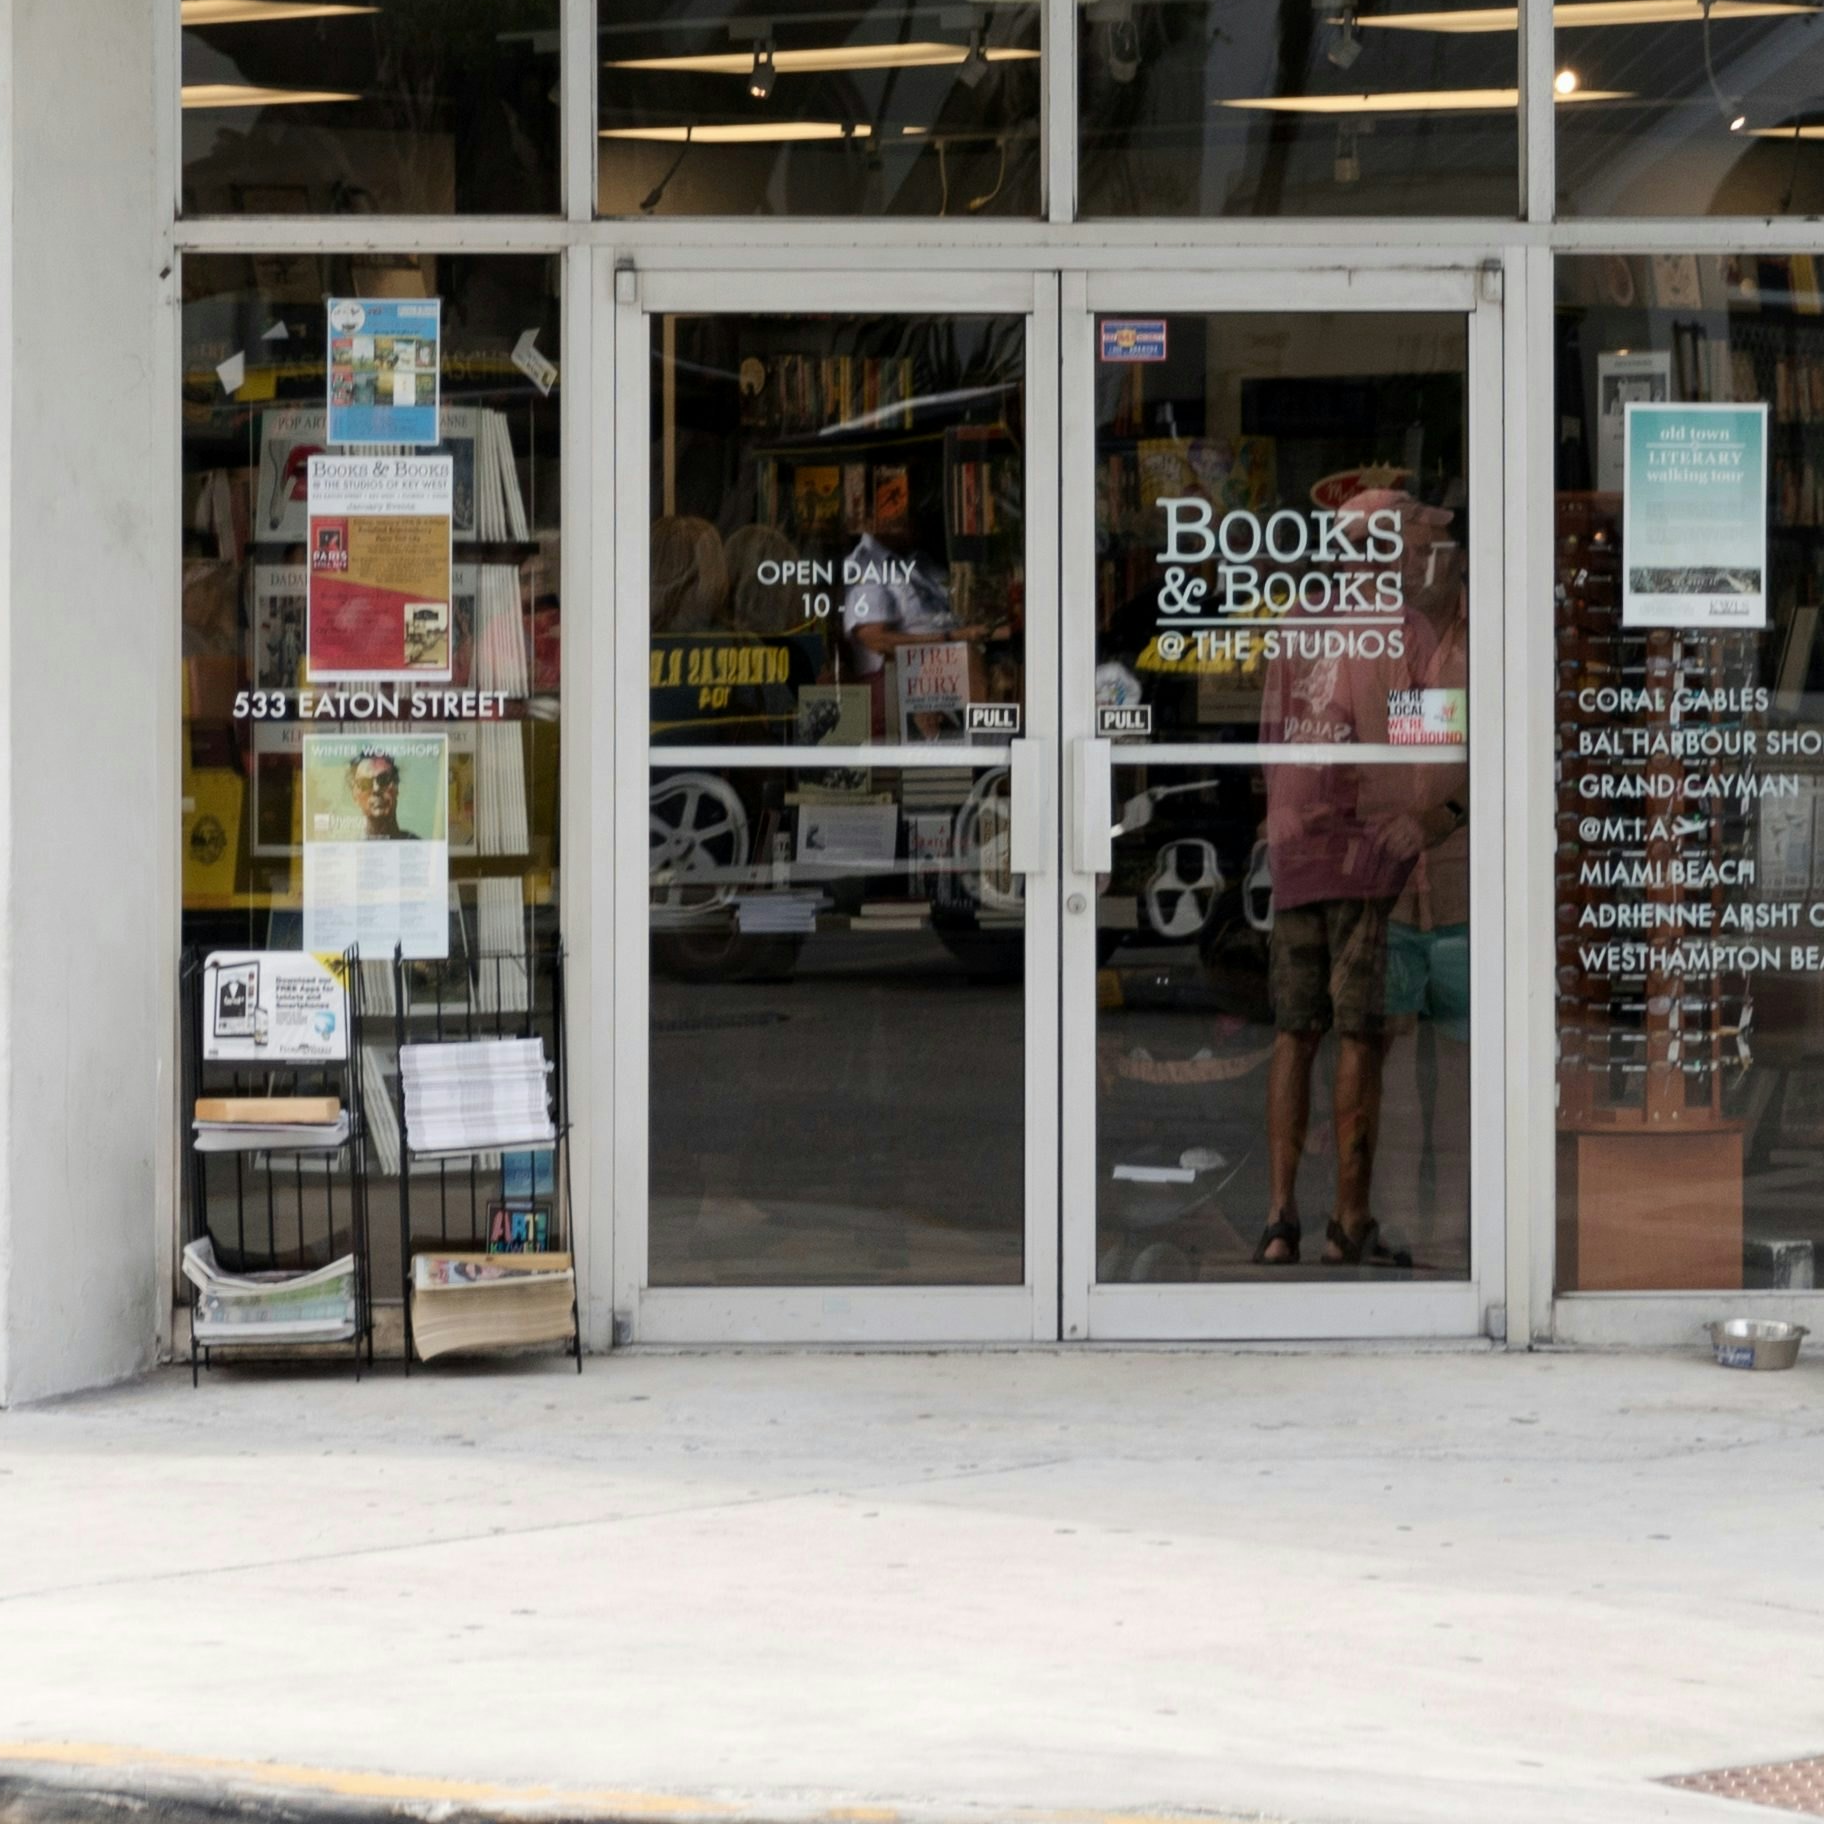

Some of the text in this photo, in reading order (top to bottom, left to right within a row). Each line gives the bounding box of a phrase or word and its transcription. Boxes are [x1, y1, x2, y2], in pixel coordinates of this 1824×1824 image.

[1659, 425, 1730, 442] old town
[312, 459, 368, 477] BOOKS
[395, 459, 449, 478] BOOKS
[1648, 450, 1744, 466] LITERARY
[1646, 467, 1745, 485] walking tour
[1155, 496, 1405, 564] BOOKS
[756, 559, 918, 586] OPEN DAILY
[1156, 565, 1405, 616] & BOOKS
[800, 593, 831, 619] 10
[853, 593, 870, 619] 6
[905, 645, 960, 666] FIRE
[1156, 629, 1405, 661] @ THE STUDIOS
[906, 675, 961, 696] FURY
[232, 691, 510, 719] 533 EATON STREET
[1578, 687, 1769, 713] CORAL GABLES
[972, 708, 1014, 728] PULL
[1103, 710, 1146, 730] PULL
[311, 743, 440, 757] WINTER WORKSHOPS
[1578, 731, 1625, 756] BAL
[1631, 731, 1757, 756] HARBOUR
[1578, 773, 1801, 799] GRAND CAYMAN
[1578, 860, 1756, 885] MIAMI BEACH
[1577, 903, 1715, 928] ADRIENNE
[1719, 903, 1802, 929] ARSHT
[1578, 946, 1782, 971] WESTHAMPTON
